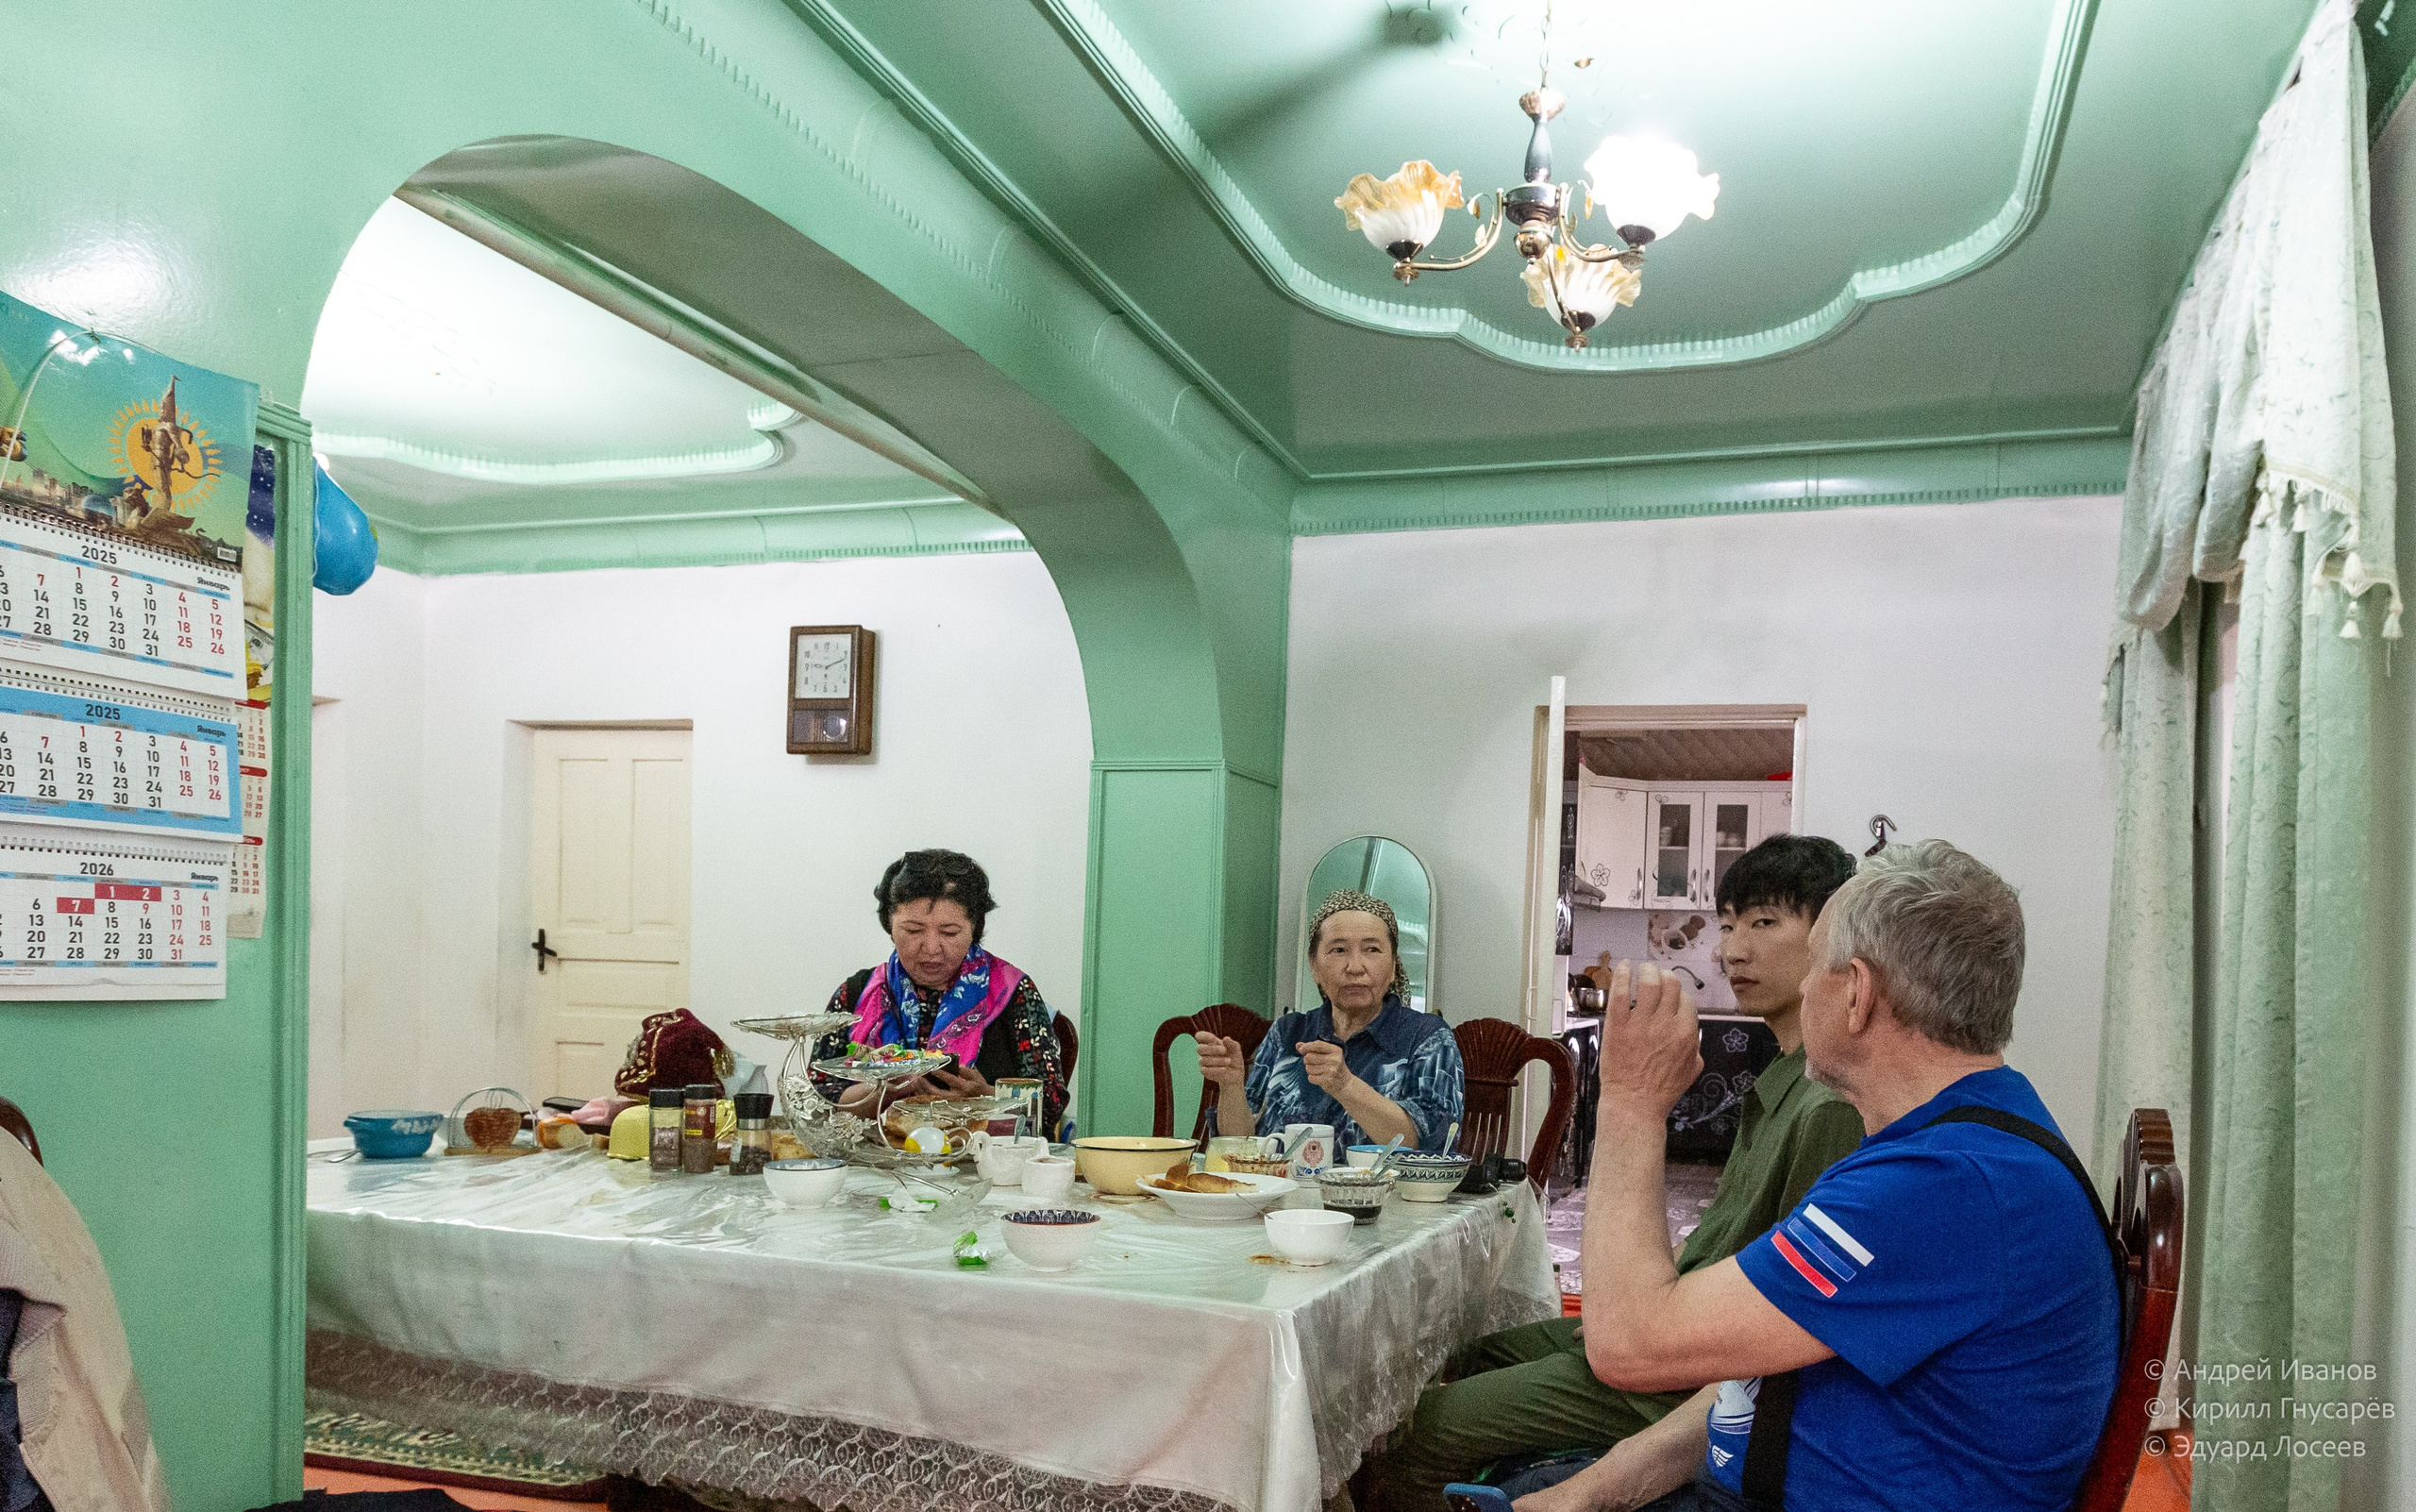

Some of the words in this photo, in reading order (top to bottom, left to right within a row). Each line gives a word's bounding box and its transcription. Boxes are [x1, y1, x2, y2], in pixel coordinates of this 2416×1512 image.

[81, 546, 117, 564] 2025
[76, 566, 81, 579] 1
[110, 576, 119, 587] 2
[145, 584, 153, 596] 3
[178, 592, 186, 603] 4
[211, 599, 219, 610] 5
[197, 577, 230, 591] Январь
[37, 574, 44, 586] 7
[76, 582, 83, 595] 8
[111, 591, 119, 602] 9
[143, 598, 157, 611] 10
[178, 606, 188, 618] 11
[210, 613, 222, 626] 12
[0, 582, 8, 595] 3
[34, 589, 49, 603] 14
[73, 597, 87, 611] 15
[109, 606, 123, 618] 16
[144, 613, 156, 626] 17
[177, 621, 191, 633] 18
[210, 628, 223, 640] 19
[0, 599, 11, 612] 0
[35, 606, 49, 619] 21
[73, 613, 89, 627] 22
[109, 621, 125, 634] 23
[143, 629, 159, 642] 24
[177, 635, 193, 648] 25
[210, 643, 225, 655] 26
[0, 615, 11, 628] 7
[33, 622, 52, 636] 28
[73, 630, 89, 643] 29
[109, 637, 126, 650] 30
[145, 644, 159, 656] 31
[85, 703, 121, 720] 2025
[196, 725, 226, 738] Январь
[80, 726, 85, 737] 1
[114, 731, 123, 743] 2
[148, 735, 156, 747] 3
[180, 741, 187, 752] 4
[210, 745, 216, 756] 5
[0, 731, 8, 744] 6
[41, 736, 49, 748] 7
[79, 741, 88, 753] 8
[115, 746, 123, 757] 9
[146, 750, 159, 763] 10
[180, 755, 189, 767] 11
[208, 760, 219, 772] 12
[37, 751, 54, 764] 14
[76, 756, 92, 769] 15
[113, 761, 126, 773] 16
[147, 765, 159, 777] 17
[179, 769, 192, 781] 18
[209, 774, 220, 785] 19
[0, 764, 15, 777] 20
[40, 768, 54, 781] 21
[76, 772, 93, 785] 22
[113, 777, 128, 789] 23
[145, 781, 162, 793] 24
[178, 784, 193, 797] 25
[209, 788, 222, 800] 26
[0, 781, 15, 794] 27
[38, 784, 57, 798] 28
[77, 788, 94, 801] 29
[113, 792, 128, 805] 30
[148, 796, 161, 808] 31
[79, 862, 114, 876] 2026
[191, 872, 219, 882] Январь
[109, 885, 115, 899] 1
[142, 887, 150, 900] 2
[173, 889, 180, 900] 3
[202, 891, 210, 902] 4
[32, 898, 41, 910] 6
[72, 899, 80, 912] 7
[108, 901, 116, 913] 8
[143, 903, 149, 915] 9
[171, 904, 183, 916] 10
[201, 906, 210, 916] 11
[29, 914, 44, 927] 13
[68, 916, 83, 928] 14
[105, 916, 119, 929] 15
[140, 917, 152, 930] 16
[171, 919, 182, 931] 17
[200, 920, 211, 932] 18
[26, 930, 45, 943] 20
[69, 932, 83, 944] 21
[104, 932, 120, 944] 22
[138, 932, 153, 945] 23
[169, 933, 184, 946] 24
[199, 934, 212, 946] 25
[27, 947, 45, 959] 27
[66, 948, 85, 959] 28
[104, 948, 120, 960] 29
[137, 948, 153, 960] 30
[171, 949, 182, 960] 31
